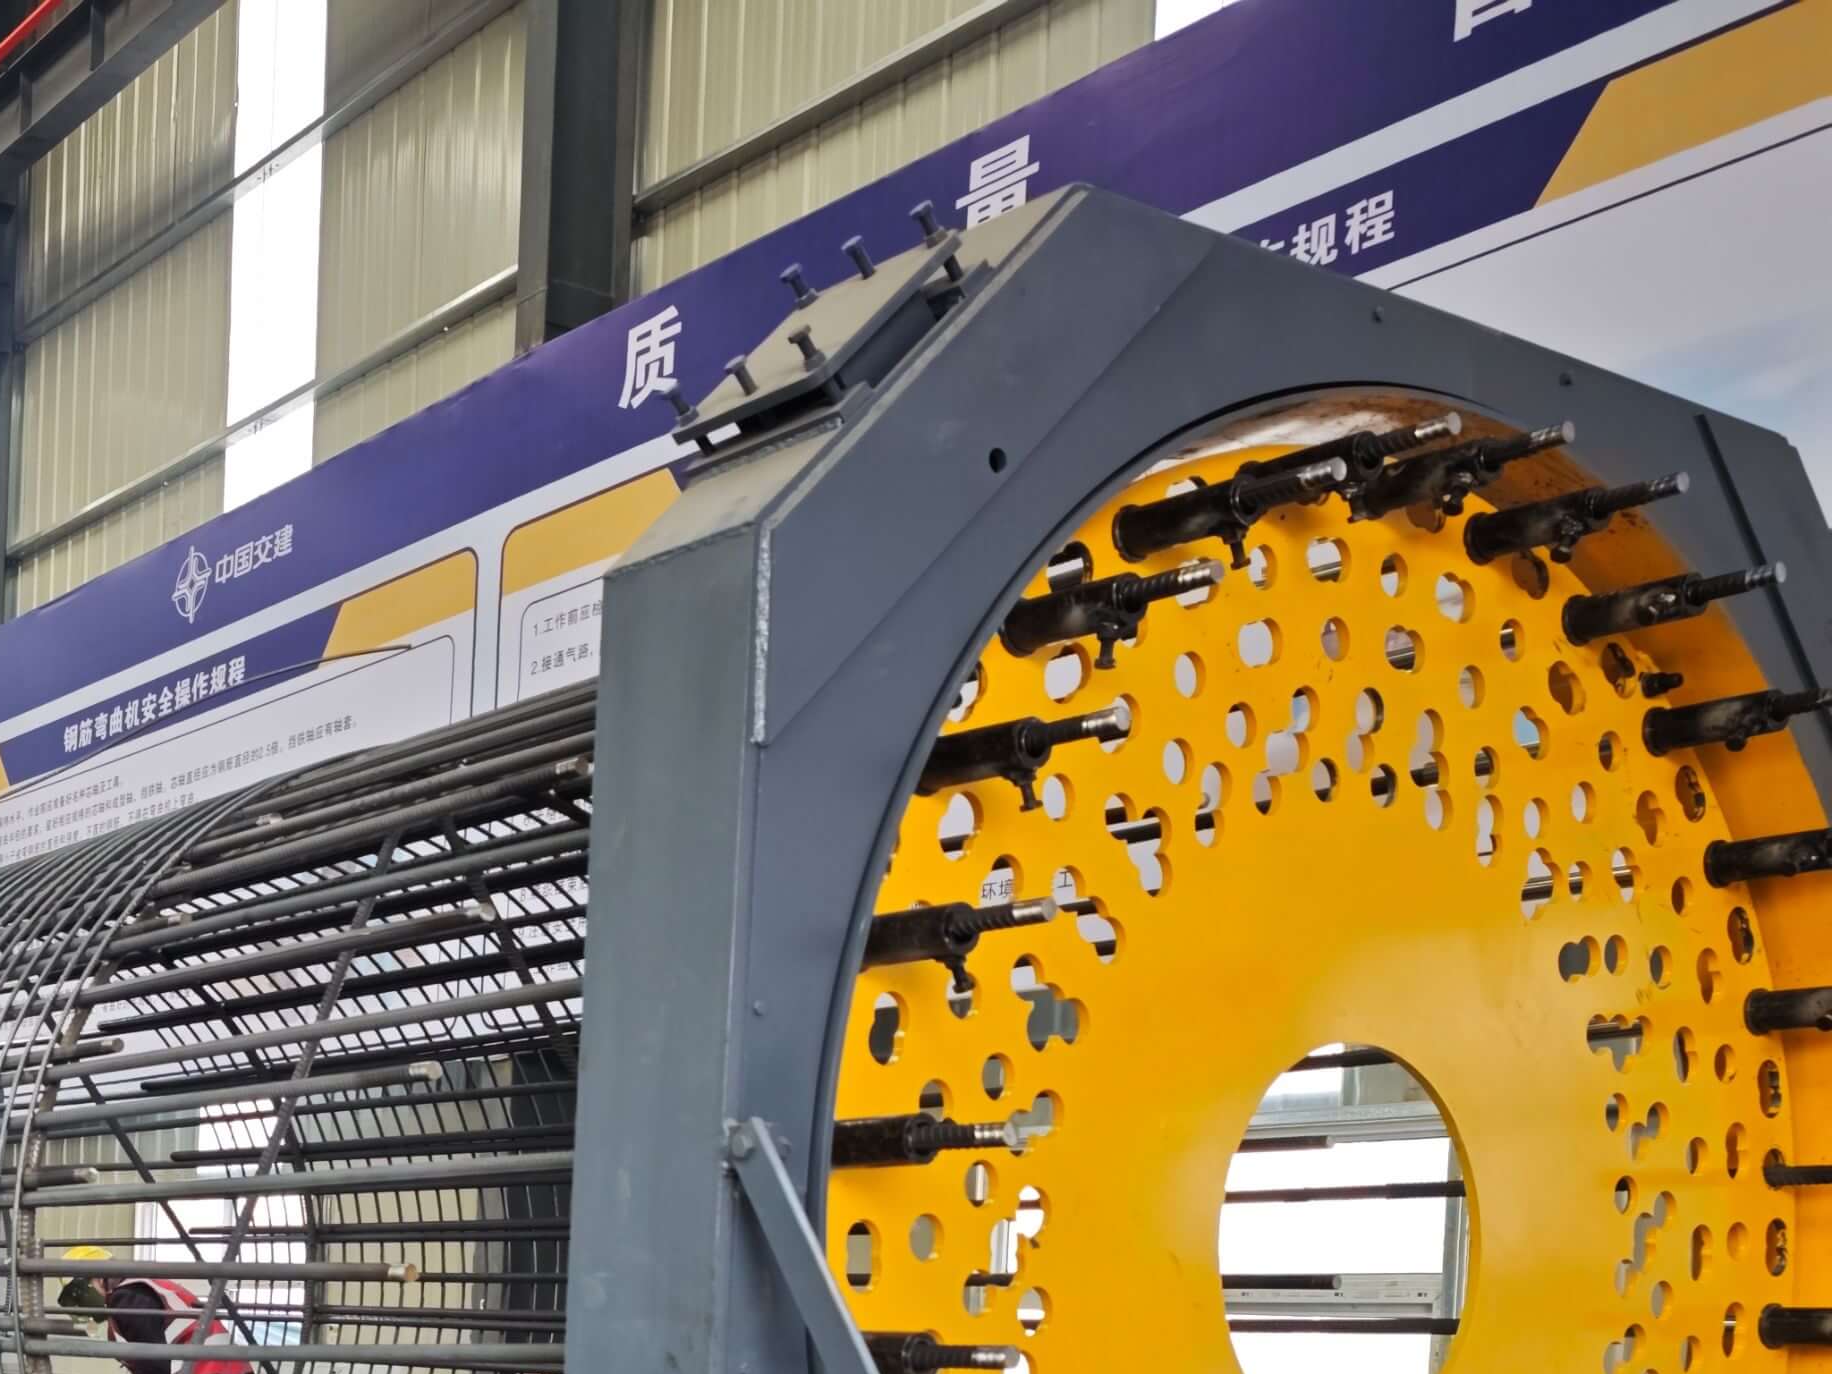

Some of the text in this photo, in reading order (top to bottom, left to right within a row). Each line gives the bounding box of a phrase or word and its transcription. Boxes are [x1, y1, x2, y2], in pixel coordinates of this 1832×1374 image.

[1260, 190, 1396, 266] 规程
[214, 524, 294, 584] 中国交建
[63, 655, 246, 752] 钢筋弯曲机安全操作规程
